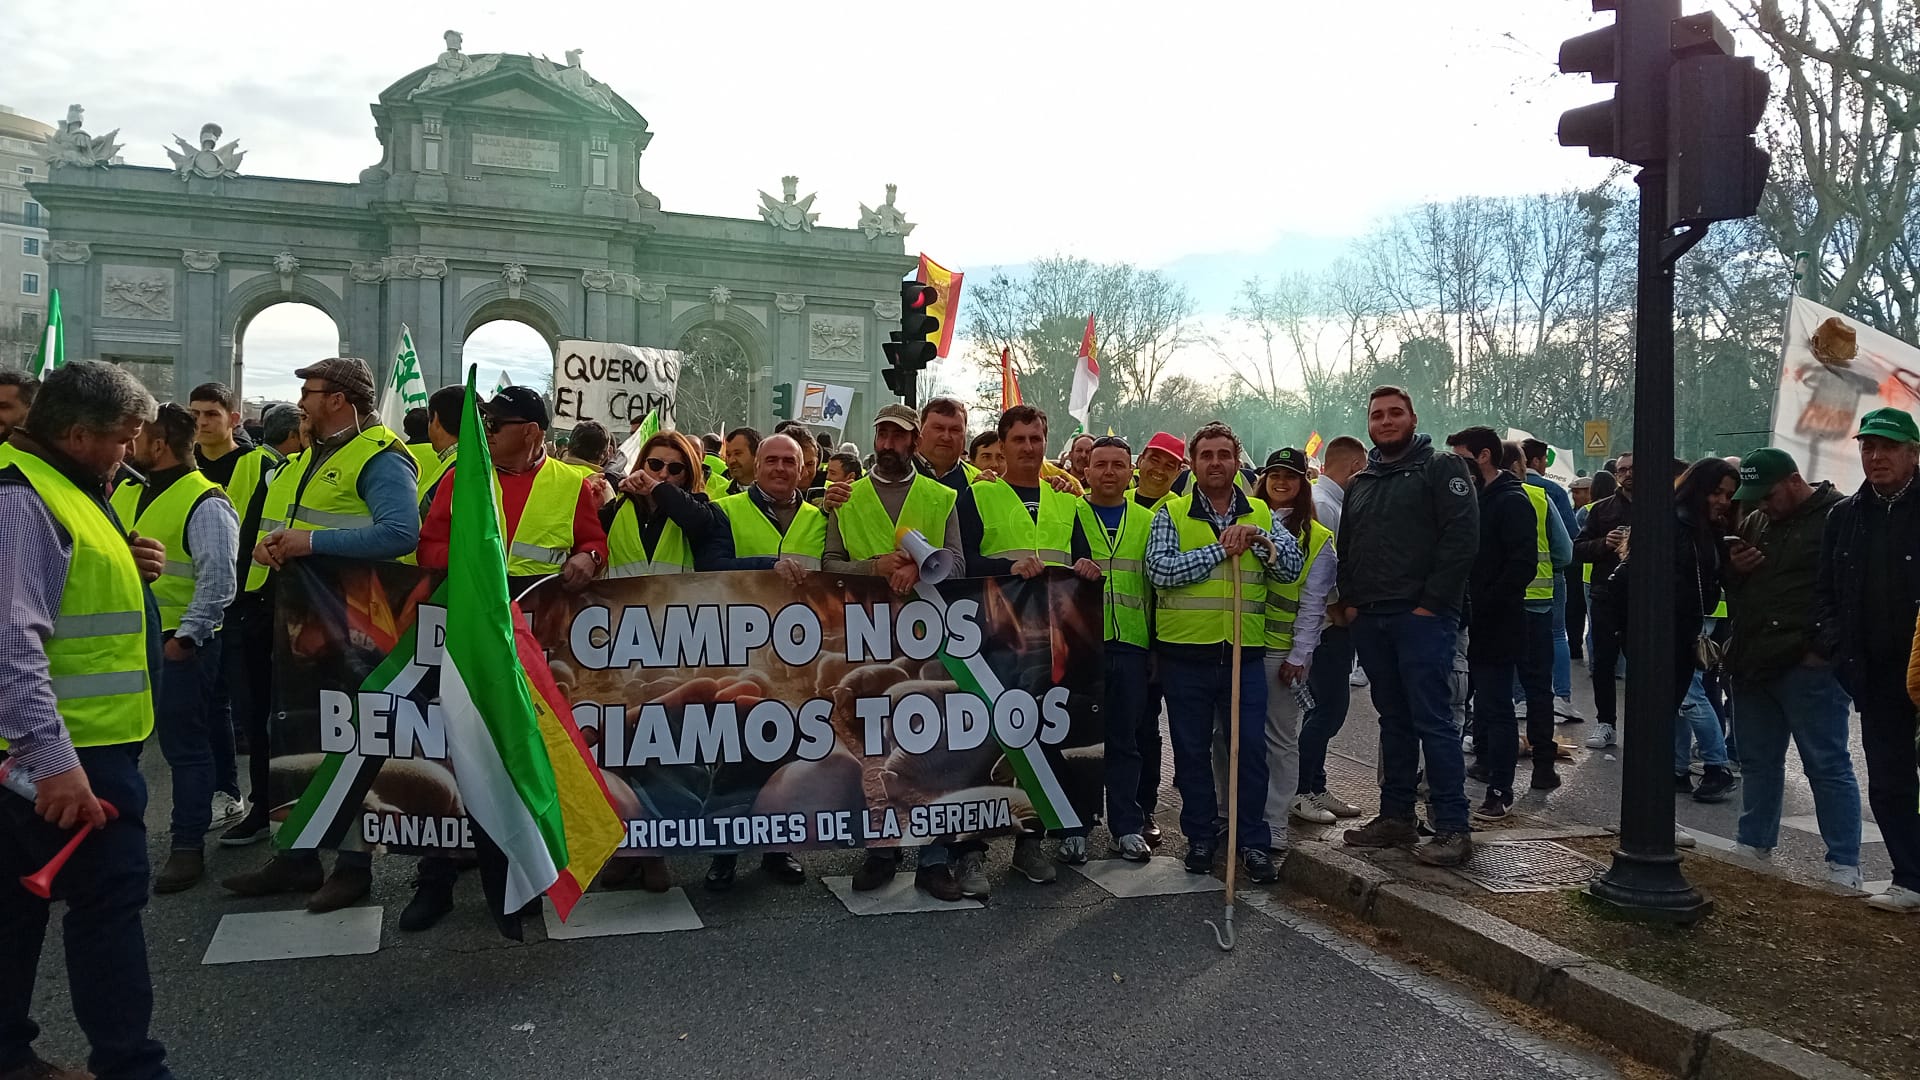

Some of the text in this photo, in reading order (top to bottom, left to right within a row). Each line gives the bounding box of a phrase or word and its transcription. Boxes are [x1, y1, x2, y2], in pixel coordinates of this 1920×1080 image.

[564, 353, 648, 384] QUERO
[555, 386, 594, 421] EL
[570, 603, 823, 671] CAMPO
[844, 598, 983, 664] NOS
[318, 685, 1071, 768] BENCIAMOS TODOS
[362, 797, 1012, 849] GANADE RICULTORES DE LA SERENA
